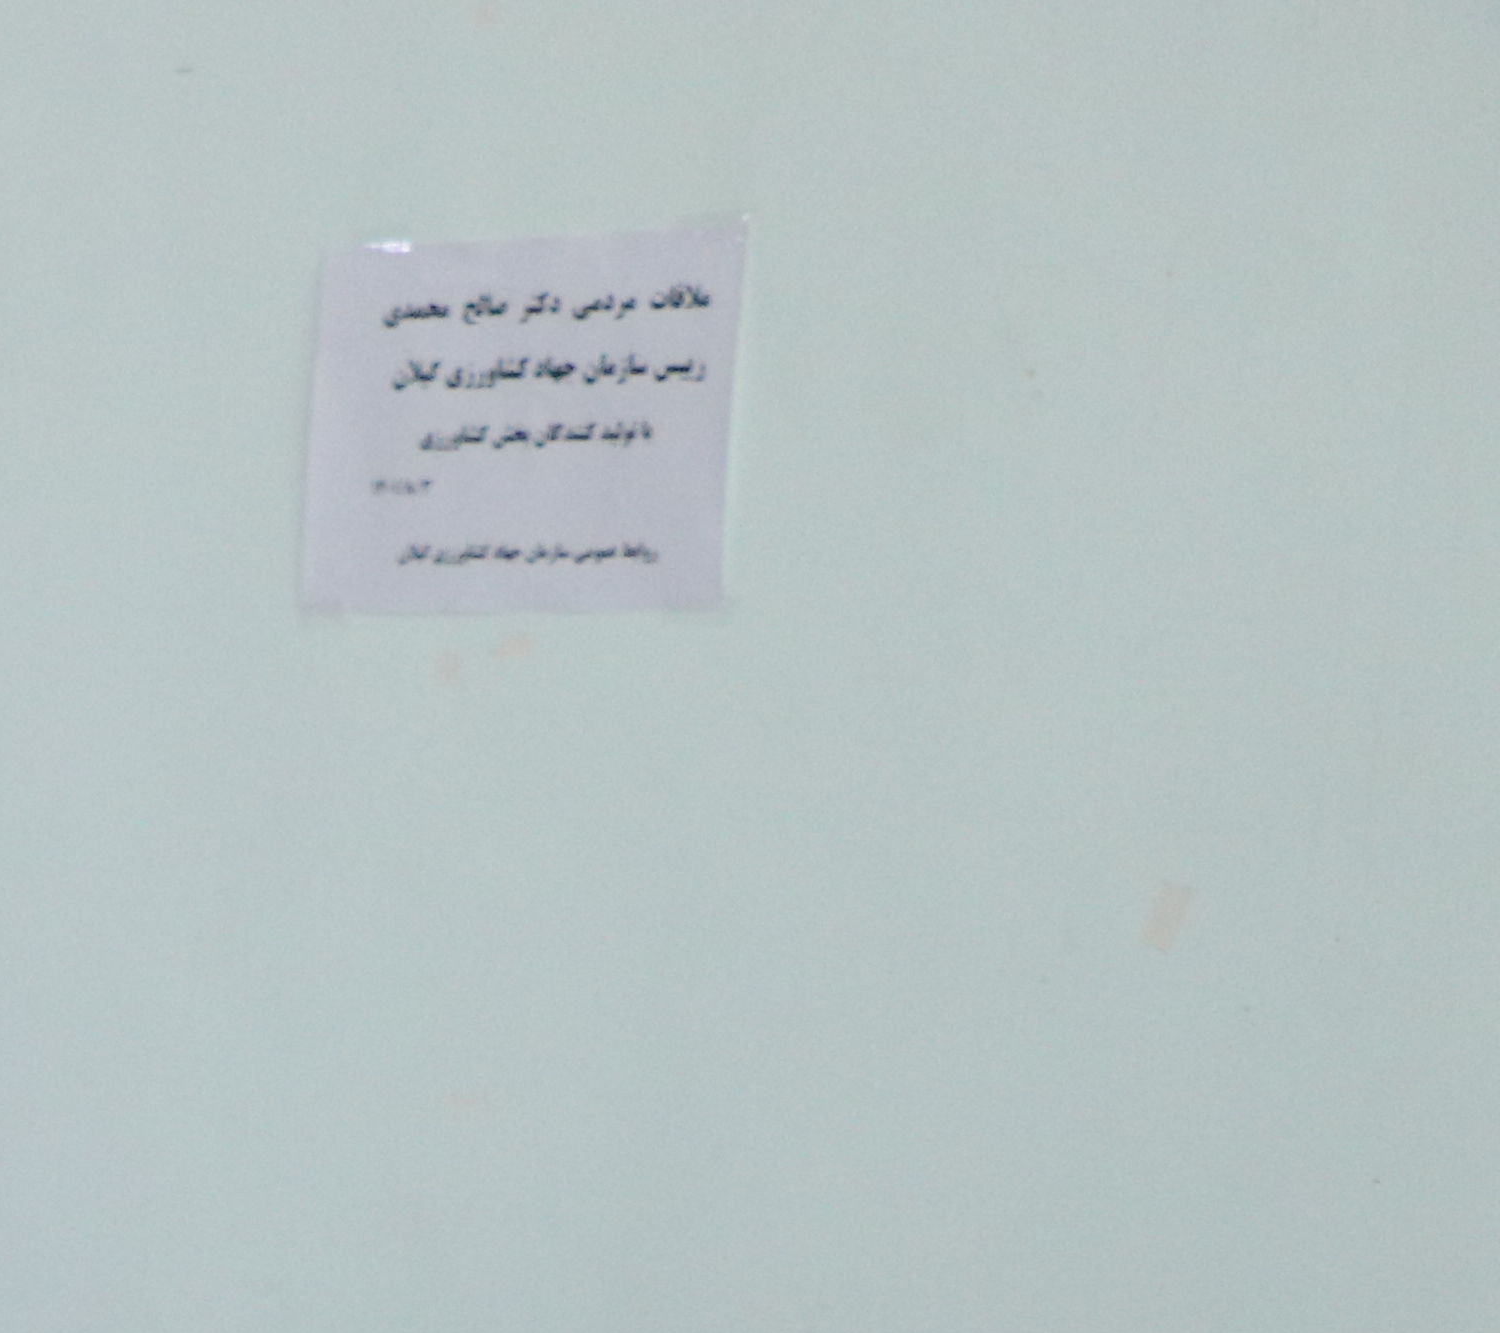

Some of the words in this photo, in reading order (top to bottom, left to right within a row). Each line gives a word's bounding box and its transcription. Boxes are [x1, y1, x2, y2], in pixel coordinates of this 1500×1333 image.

[519, 291, 561, 323] دکتر
[573, 294, 637, 320] مردمی
[650, 282, 710, 309] ملاقات
[393, 359, 441, 390] گیلان
[446, 357, 529, 389] کشاورزی
[534, 356, 576, 383] جهاد
[584, 352, 649, 386] سازمان
